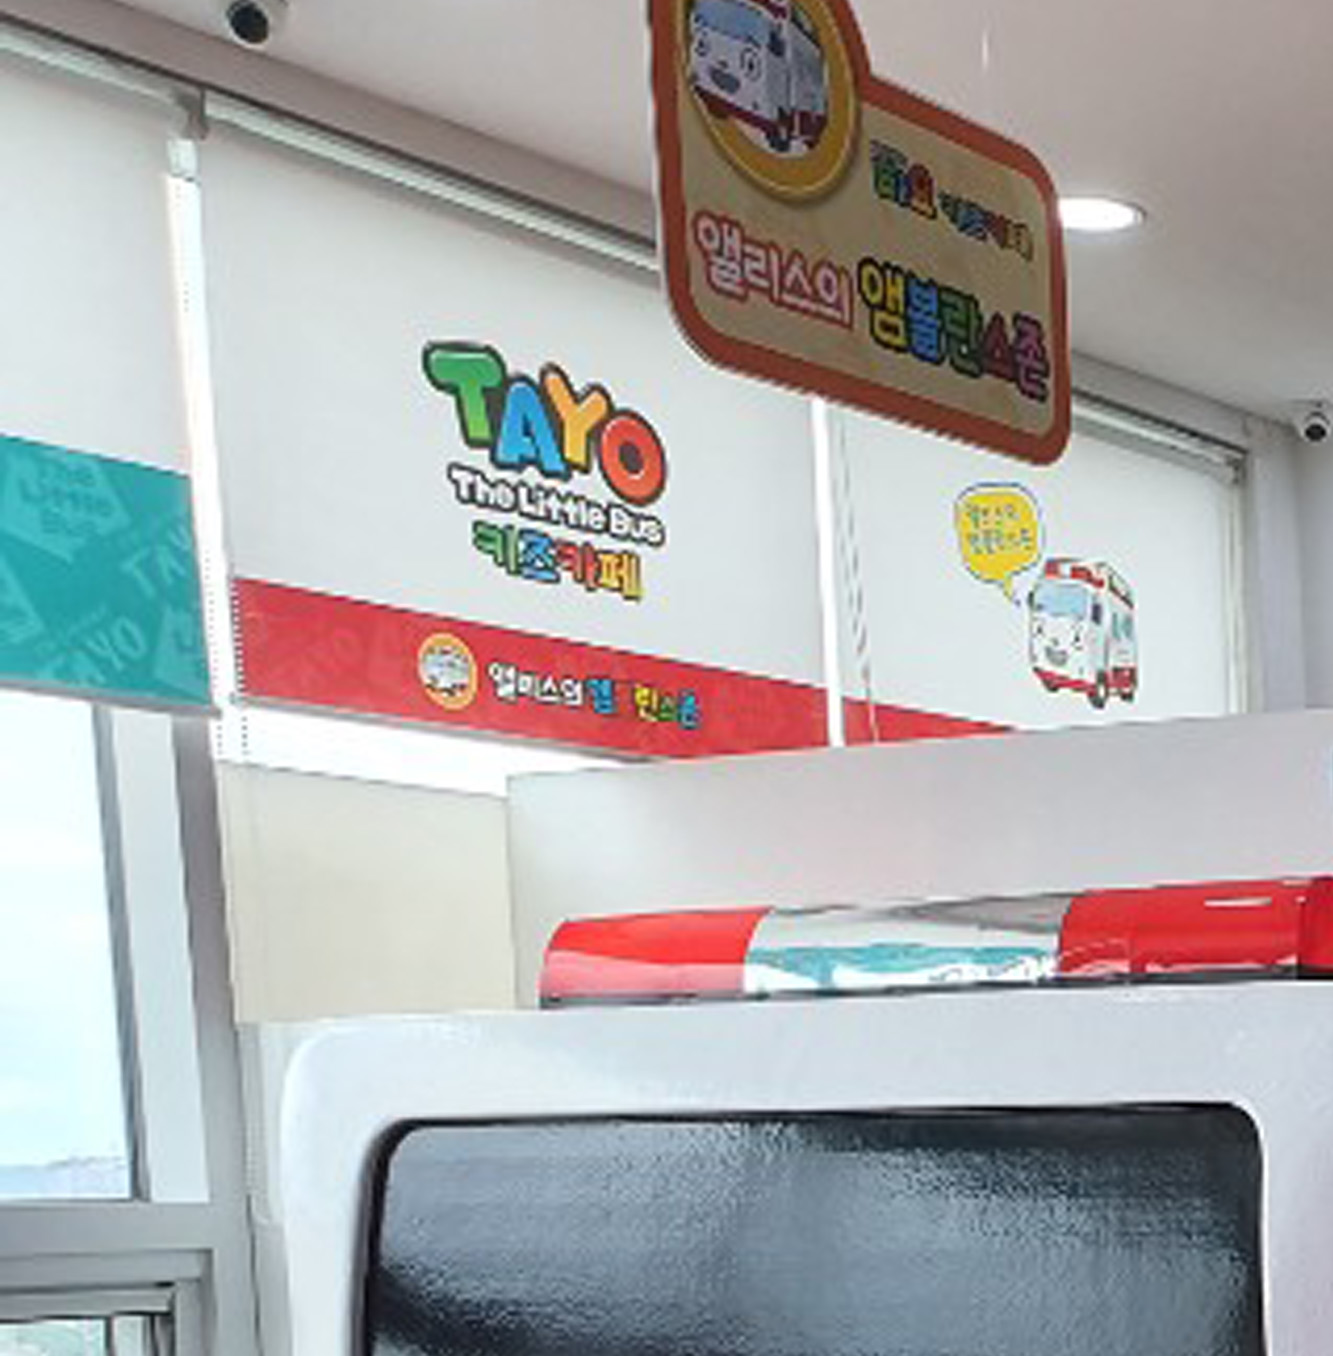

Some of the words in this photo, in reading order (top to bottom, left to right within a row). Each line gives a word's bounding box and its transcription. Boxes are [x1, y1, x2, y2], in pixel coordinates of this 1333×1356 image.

[693, 211, 853, 329] 앨리스의
[423, 340, 668, 507] TAYO
[448, 462, 517, 512] The
[516, 481, 607, 533] Little
[606, 502, 666, 548] Bus
[471, 519, 643, 602] 키즈카페
